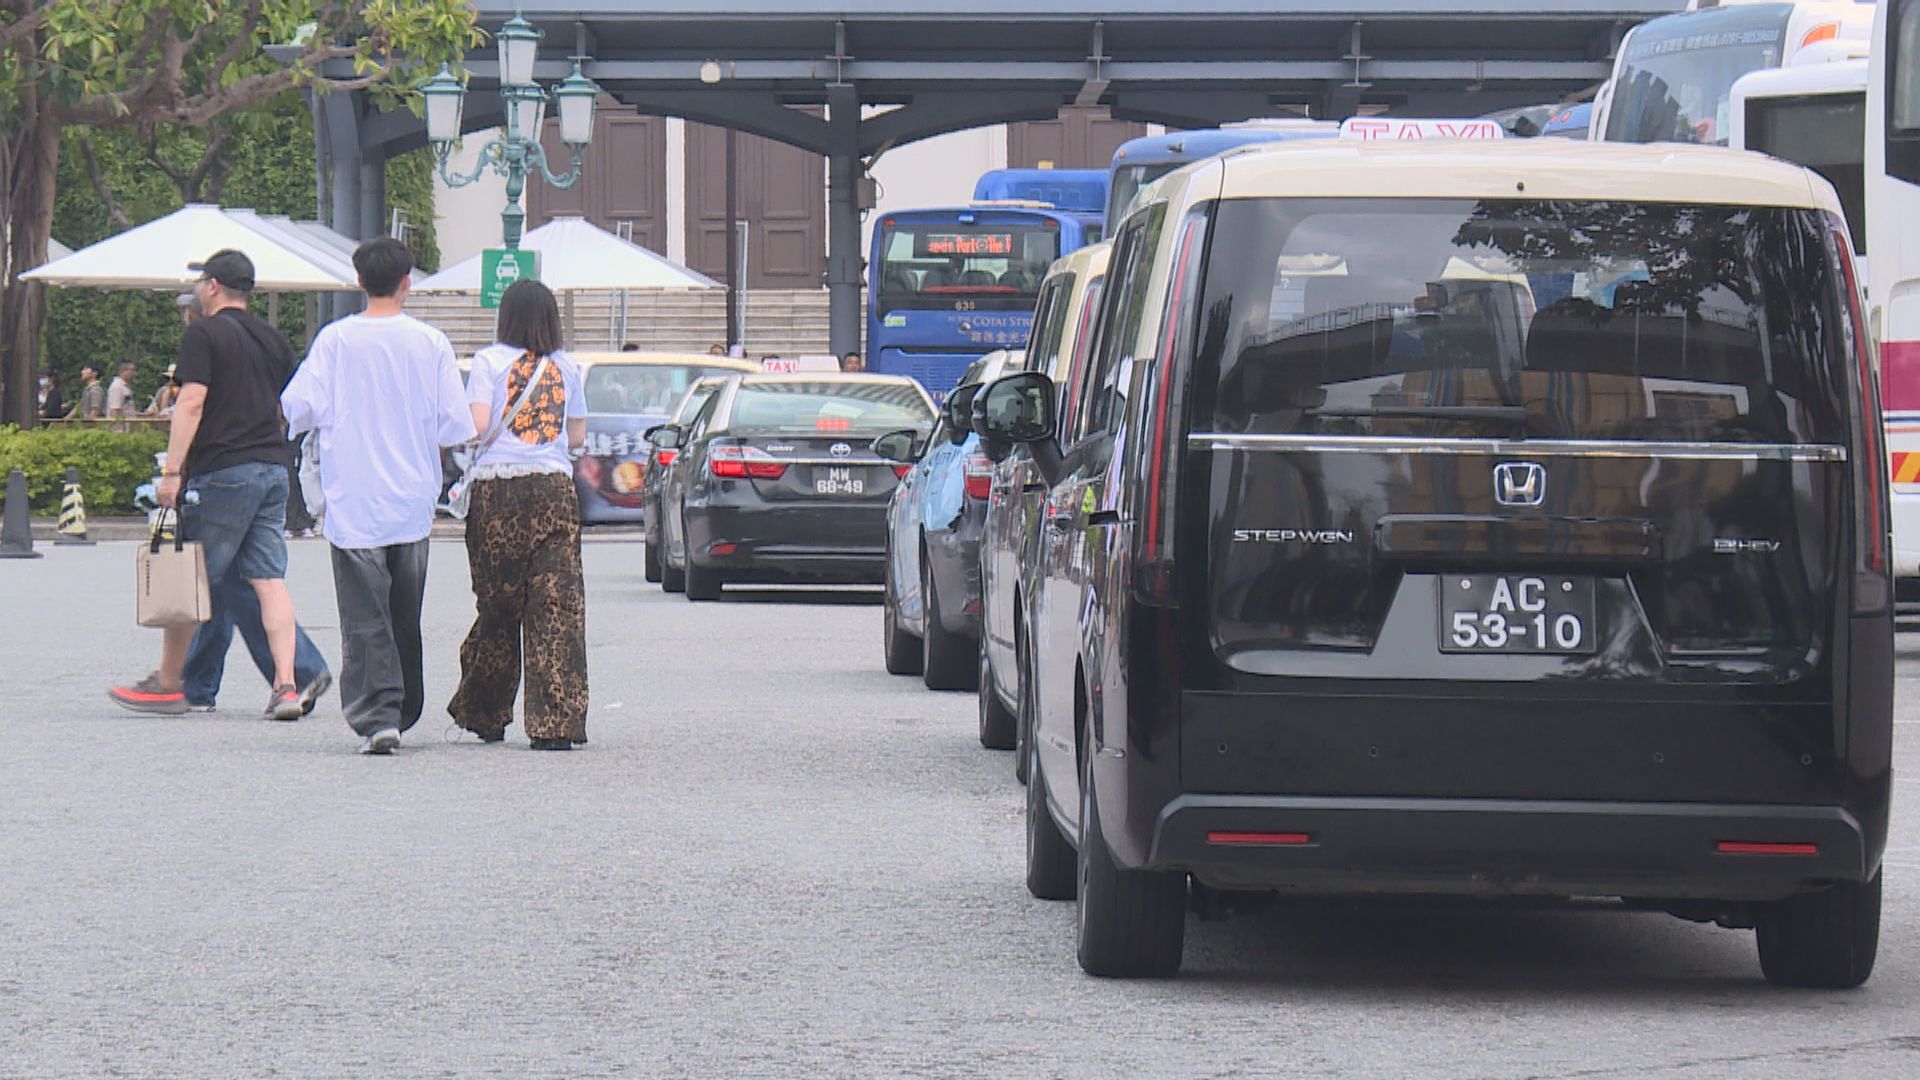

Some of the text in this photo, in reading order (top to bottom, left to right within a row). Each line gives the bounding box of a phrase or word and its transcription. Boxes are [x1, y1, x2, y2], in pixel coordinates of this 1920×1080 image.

[766, 362, 797, 372] TAXI
[829, 467, 850, 481] MW
[1489, 577, 1546, 612] AC
[1451, 611, 1582, 649] 53-10
